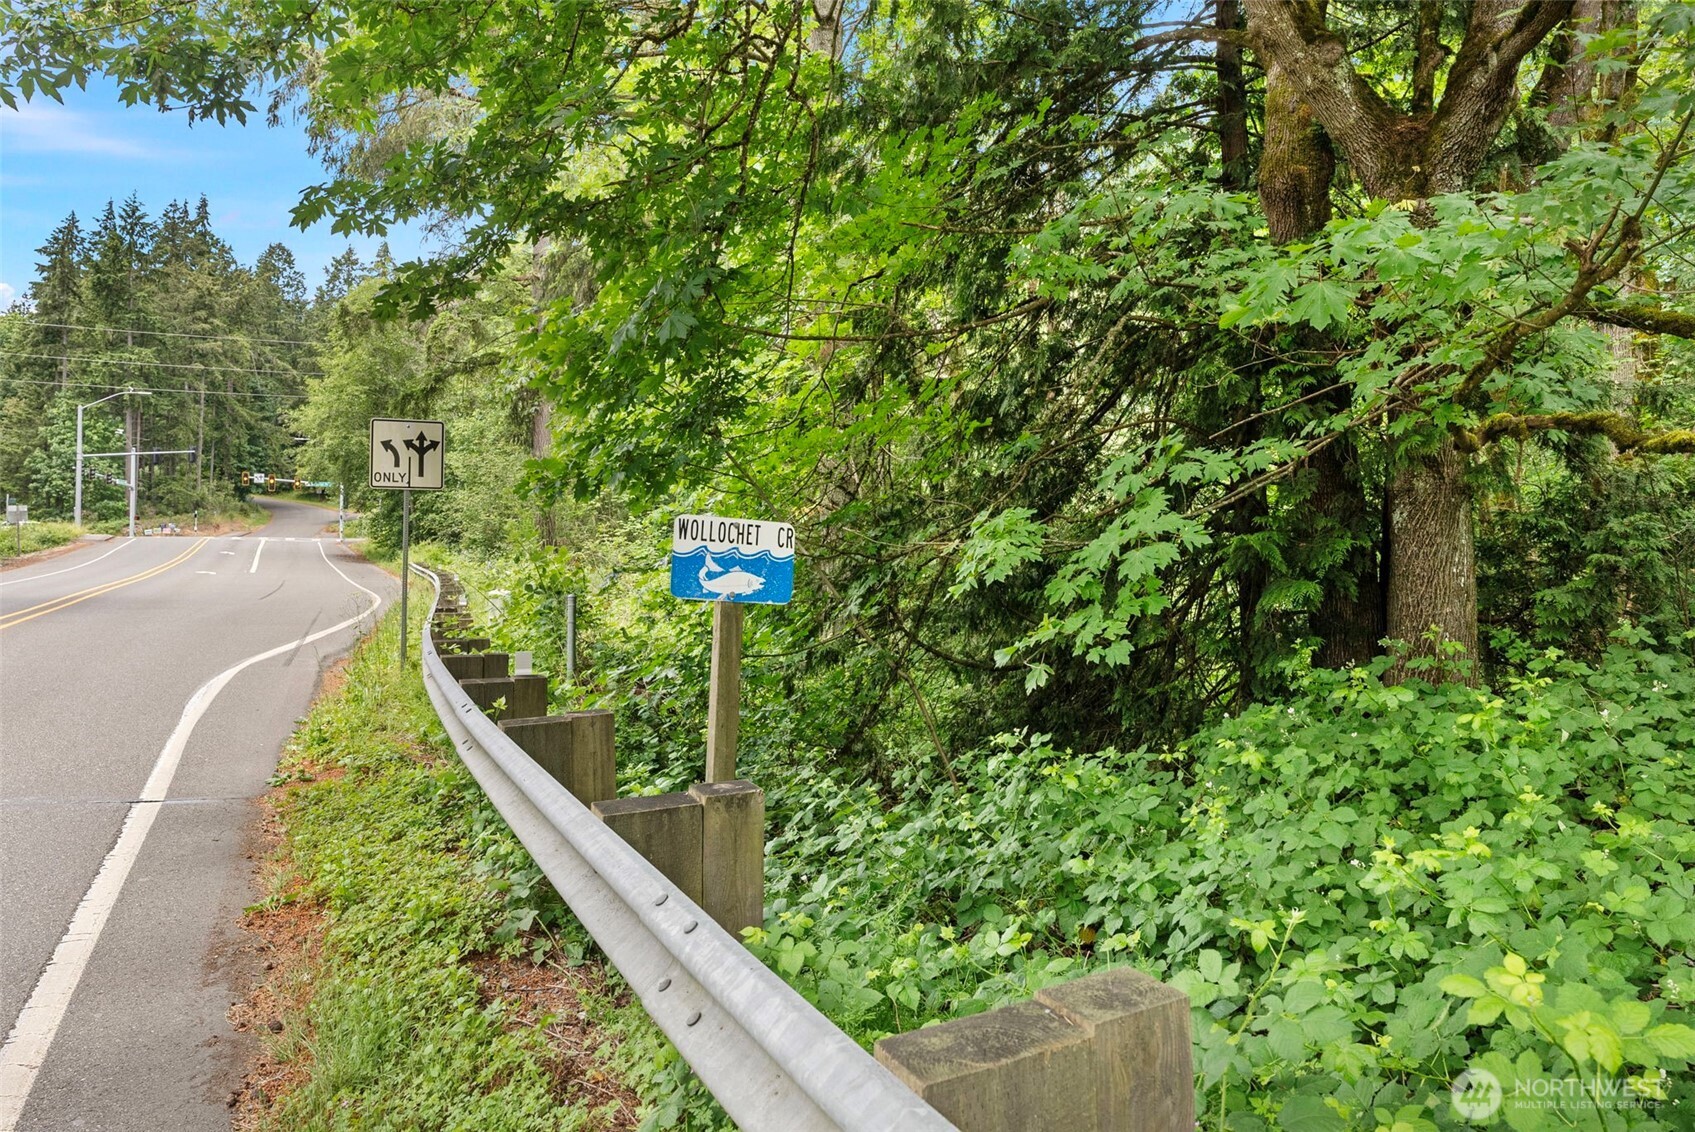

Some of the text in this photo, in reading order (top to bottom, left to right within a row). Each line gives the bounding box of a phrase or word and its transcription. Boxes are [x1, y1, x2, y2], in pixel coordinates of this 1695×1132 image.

[374, 471, 407, 483] ONLY
[678, 518, 794, 549] WOLLOCHET CR
